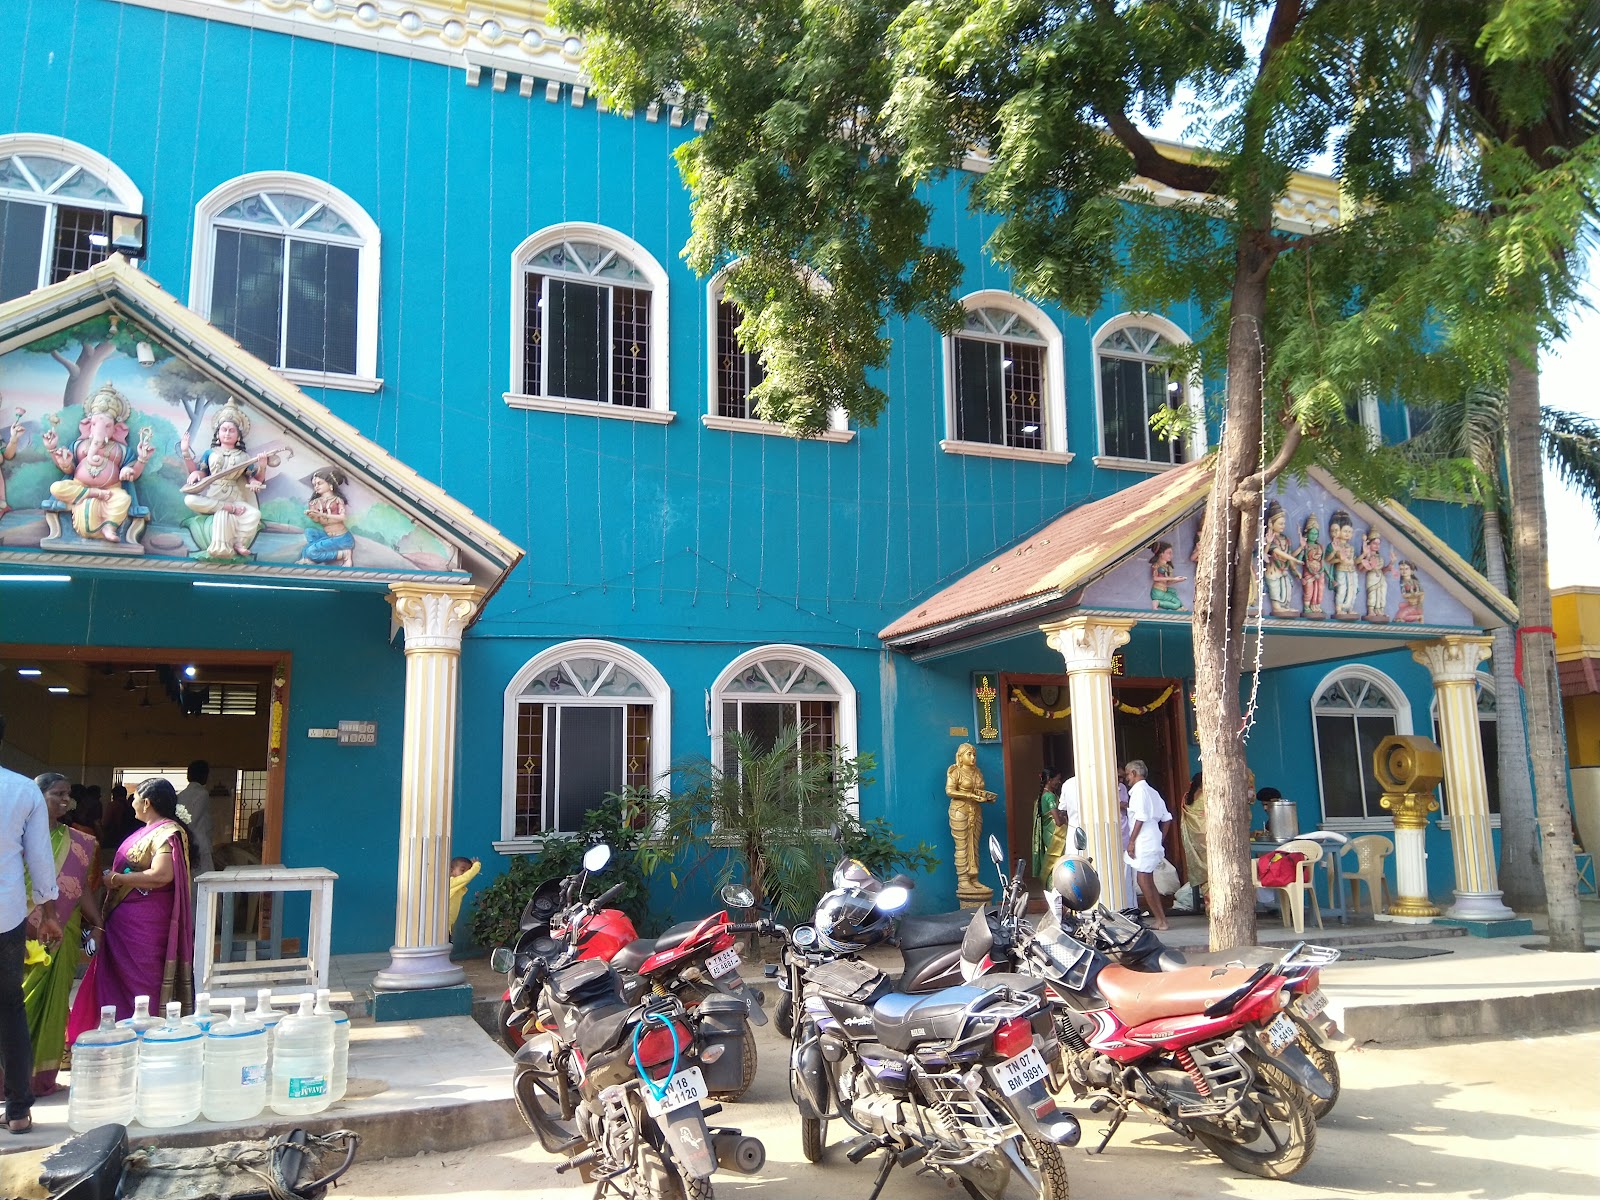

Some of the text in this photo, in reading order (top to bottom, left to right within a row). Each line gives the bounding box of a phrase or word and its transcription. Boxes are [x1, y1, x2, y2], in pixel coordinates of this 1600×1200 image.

[1268, 1020, 1284, 1037] TN 05
[1279, 1026, 1294, 1042] 5419
[1005, 1054, 1031, 1075] TN 07
[676, 1077, 689, 1090] 18
[1007, 1063, 1044, 1091] BM 9891
[301, 1085, 324, 1096] JAYAM
[674, 1087, 698, 1104] 1120
